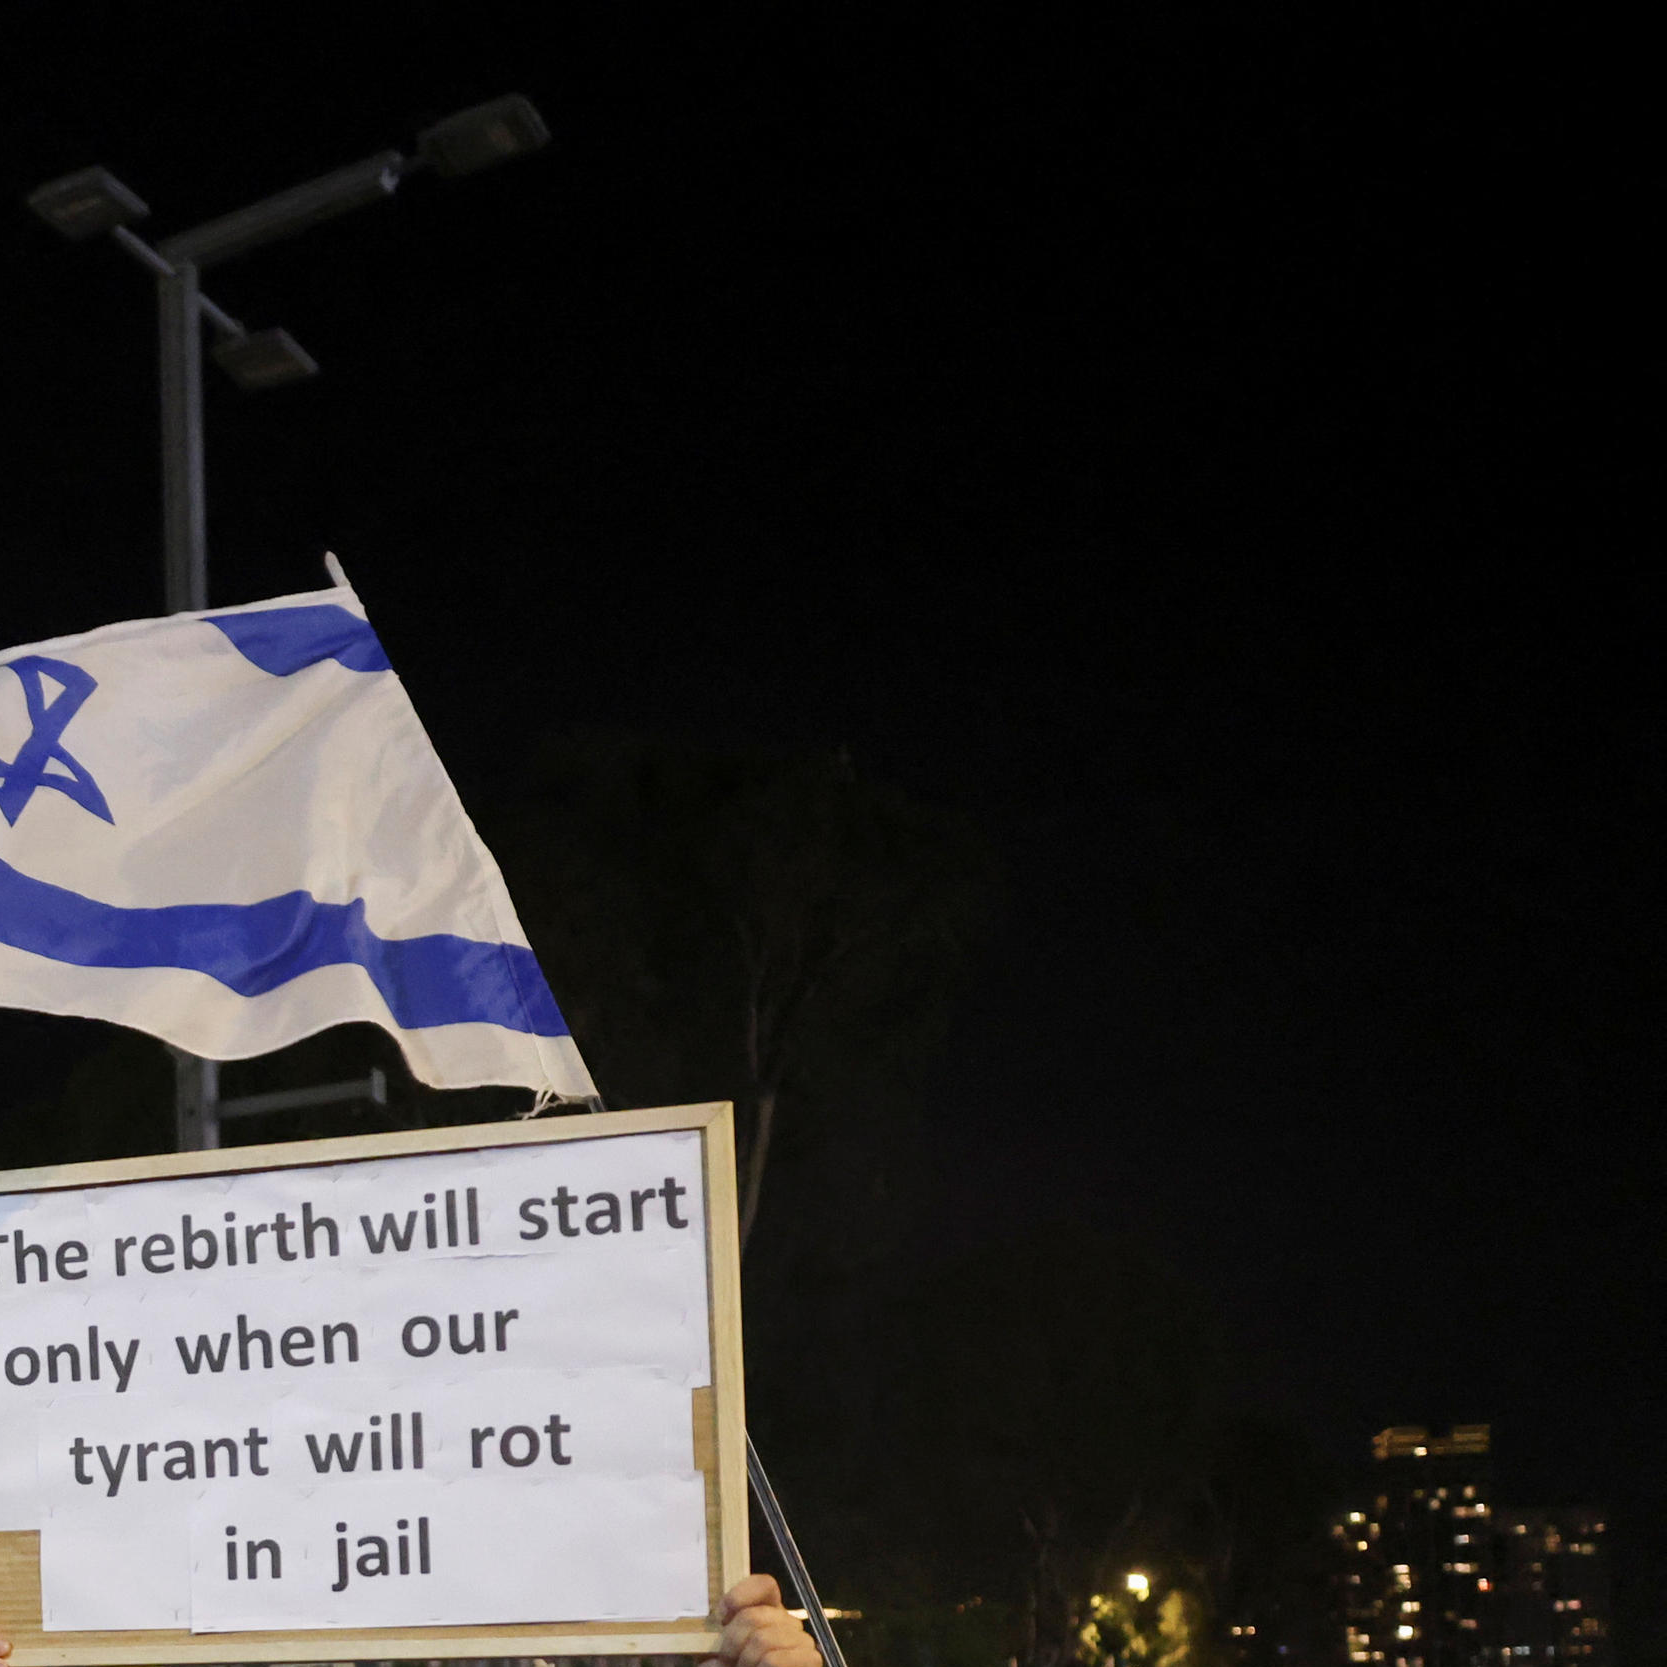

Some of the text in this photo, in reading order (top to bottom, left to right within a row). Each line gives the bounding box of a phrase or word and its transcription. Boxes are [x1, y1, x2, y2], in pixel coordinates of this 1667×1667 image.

[116, 1203, 339, 1276] rebirth
[361, 1188, 479, 1253] will
[520, 1178, 688, 1240] start
[5, 1310, 518, 1392] only when our
[70, 1413, 571, 1497] tyrant will rot
[226, 1517, 430, 1592] in jail
